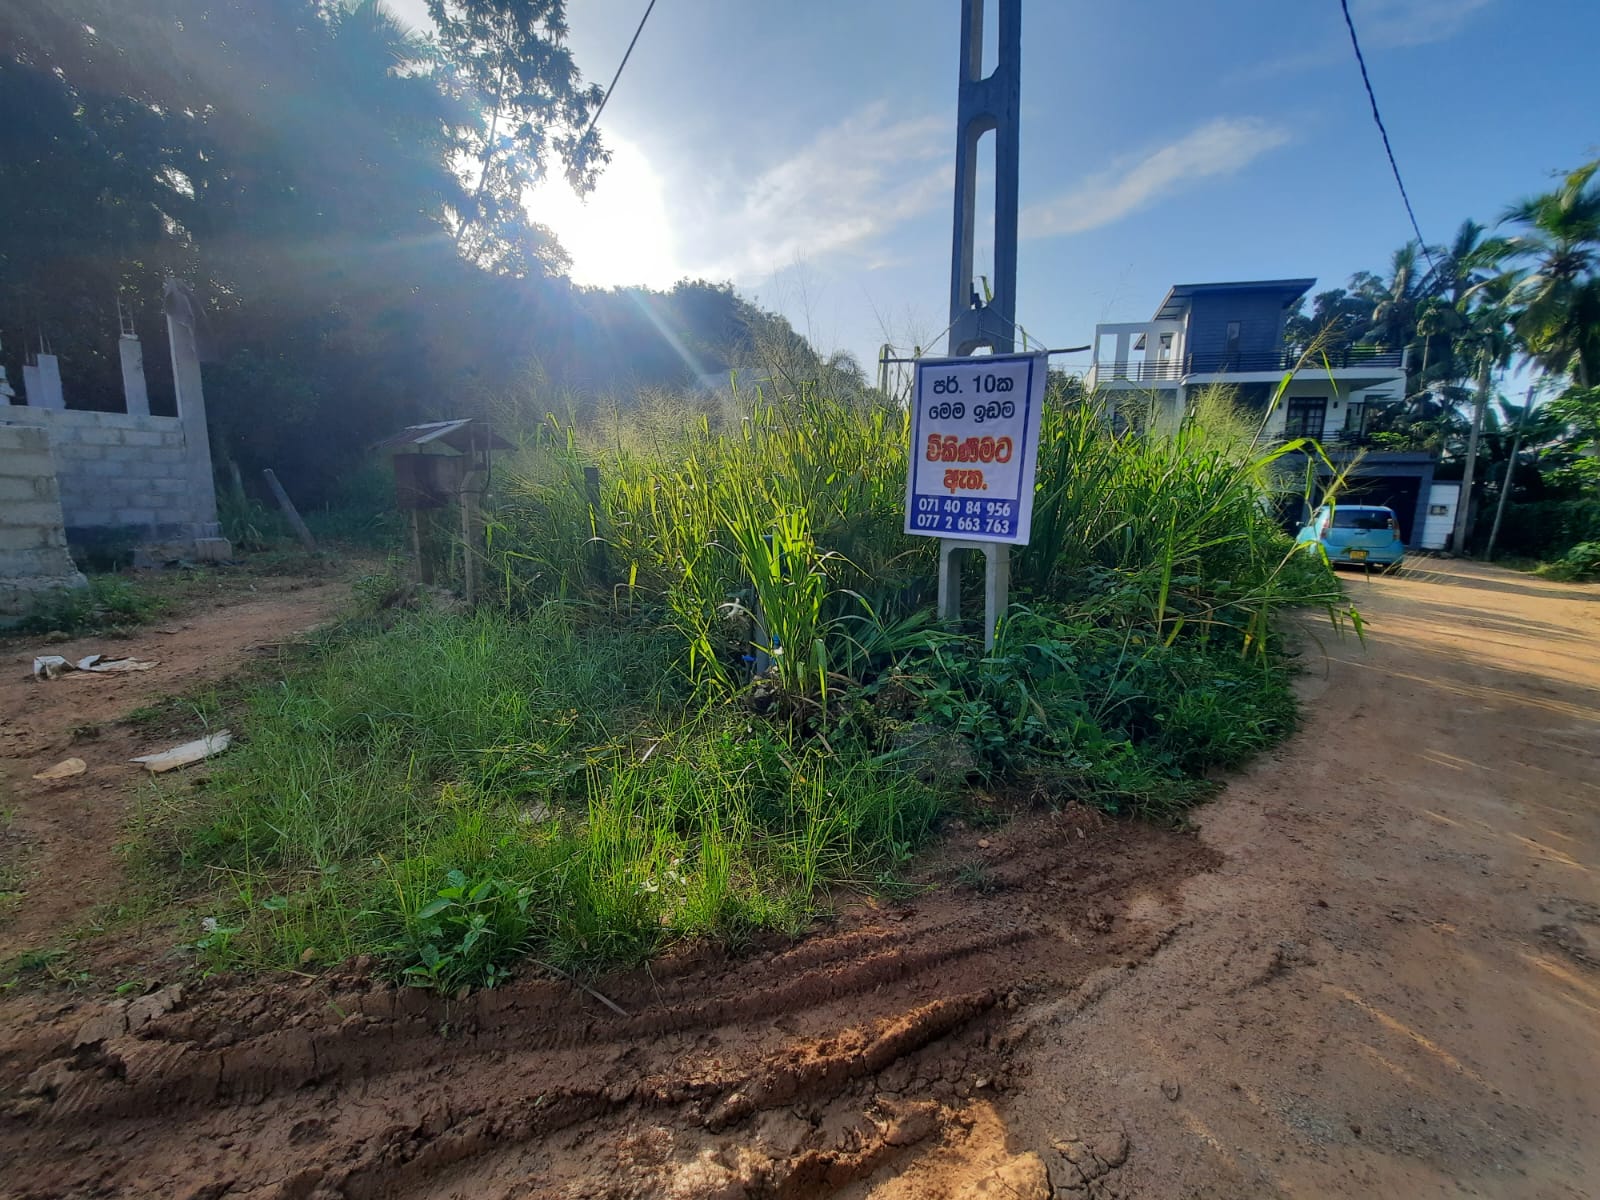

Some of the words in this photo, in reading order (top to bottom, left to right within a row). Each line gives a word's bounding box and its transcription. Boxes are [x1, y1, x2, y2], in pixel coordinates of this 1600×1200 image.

[929, 402, 965, 419] මෙම
[974, 401, 1014, 423] ඉඩම
[919, 498, 939, 511] 071
[944, 500, 960, 513] 40
[966, 501, 980, 514] 84
[987, 503, 1010, 516] 956
[917, 514, 940, 528] 077
[945, 517, 952, 529] 2
[958, 517, 980, 532] 663
[986, 519, 1009, 534] 763
